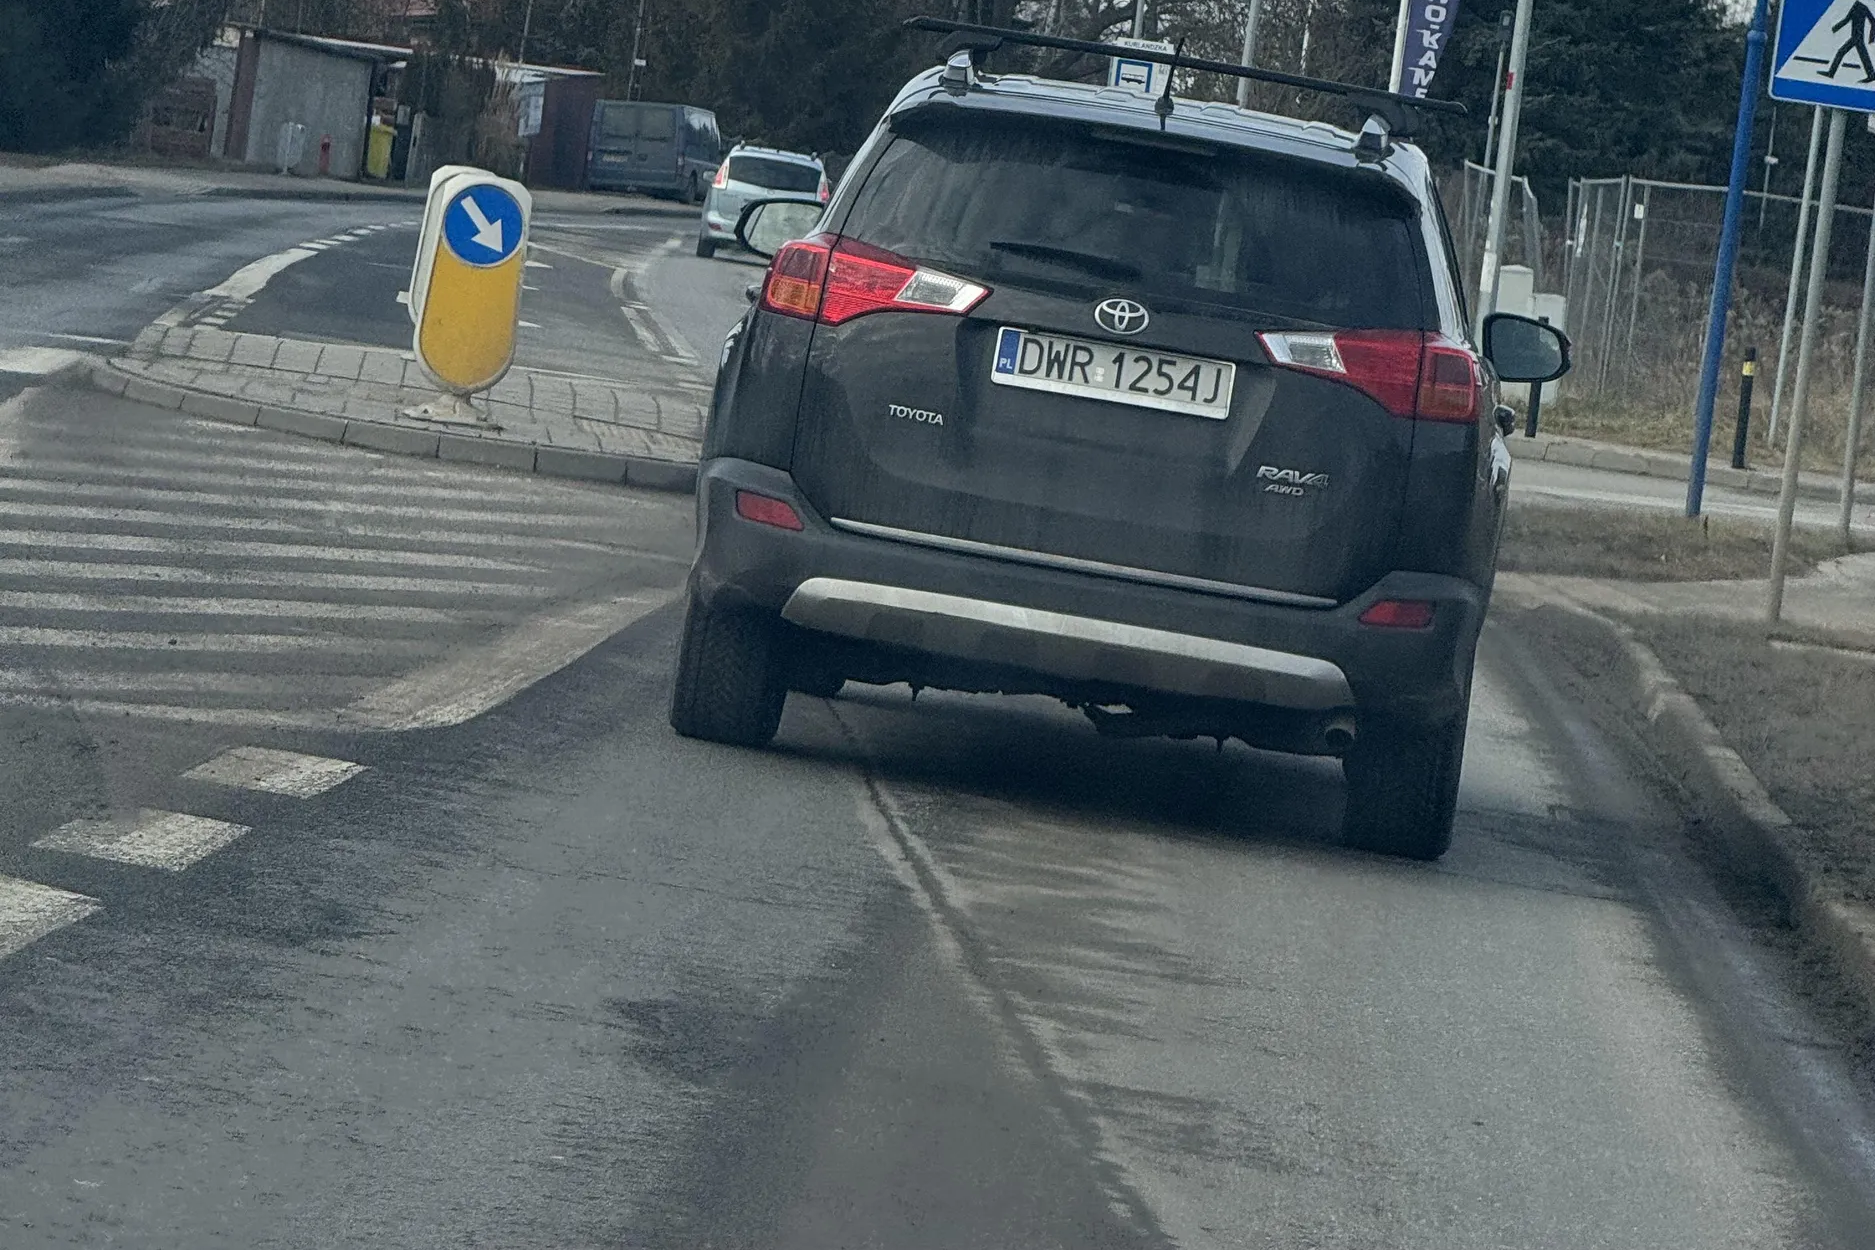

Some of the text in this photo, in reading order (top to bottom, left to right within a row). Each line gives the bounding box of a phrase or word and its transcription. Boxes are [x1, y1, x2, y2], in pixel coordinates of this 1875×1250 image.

[999, 357, 1013, 370] PL
[1018, 337, 1222, 404] DWR 1254J
[888, 404, 944, 425] TOYOTA
[1256, 465, 1330, 488] RAV4
[1264, 484, 1304, 496] AWD
